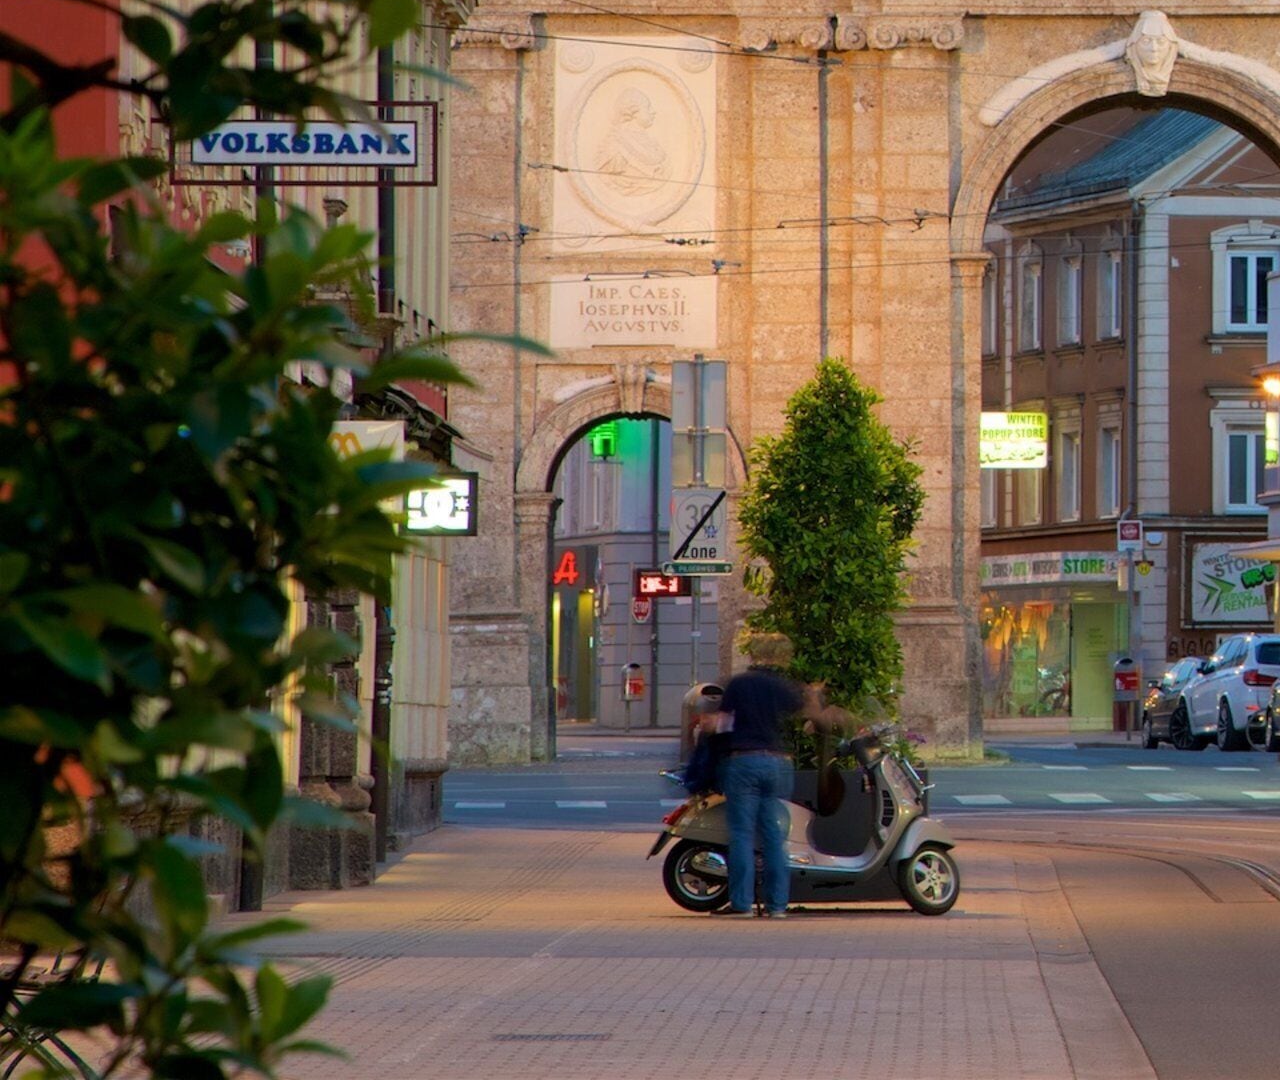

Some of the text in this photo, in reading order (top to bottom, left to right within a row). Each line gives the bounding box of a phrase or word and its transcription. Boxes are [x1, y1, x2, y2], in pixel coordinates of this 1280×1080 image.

[200, 132, 411, 155] VOLKSBANK
[1007, 414, 1043, 426] WINTER
[982, 427, 1045, 440] POPUP STORE
[682, 545, 717, 559] Zone
[1063, 558, 1105, 575] STORE
[634, 600, 649, 615] STOP
[1223, 594, 1267, 613] RENTAL
